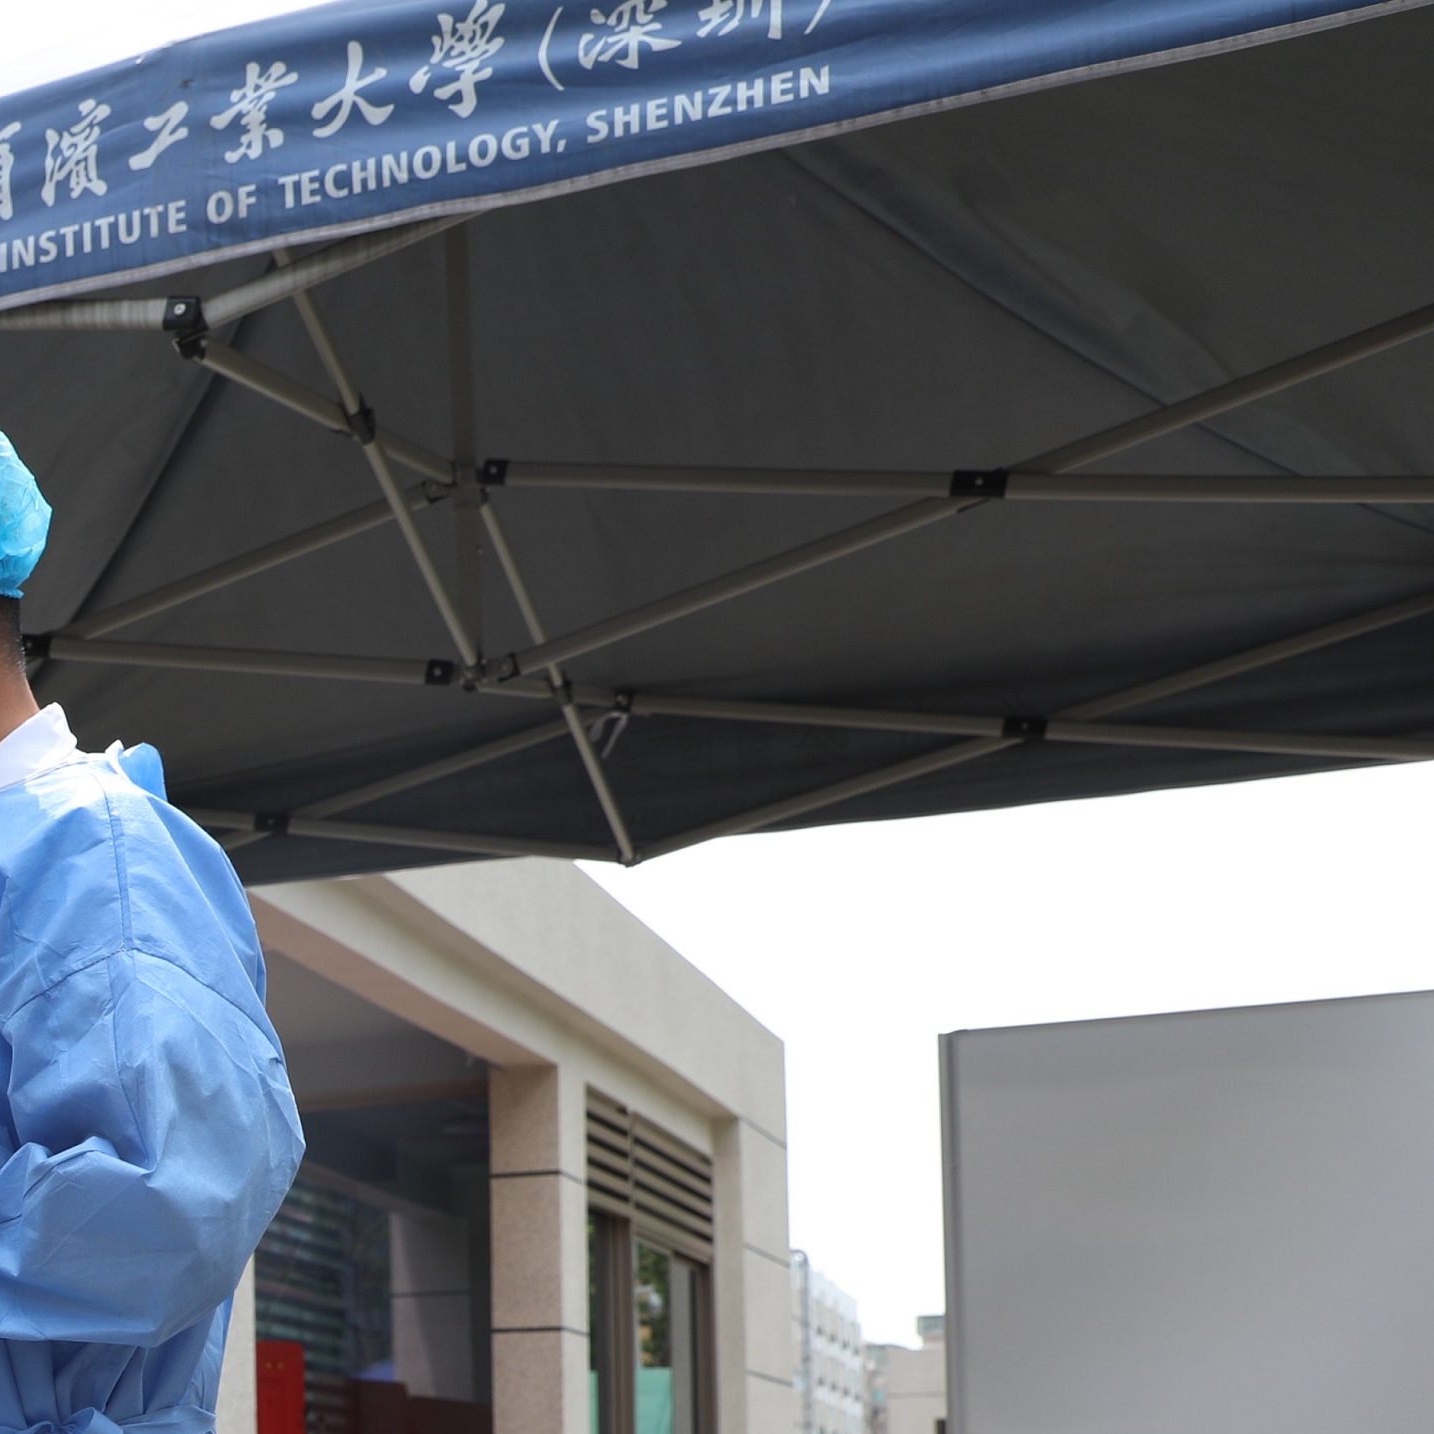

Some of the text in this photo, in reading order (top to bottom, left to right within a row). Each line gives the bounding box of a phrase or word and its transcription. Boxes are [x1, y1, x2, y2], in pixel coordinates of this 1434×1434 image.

[206, 185, 256, 224] OF
[278, 119, 566, 209] TECHNOLOGY,
[587, 65, 830, 144] SHENZHEN
